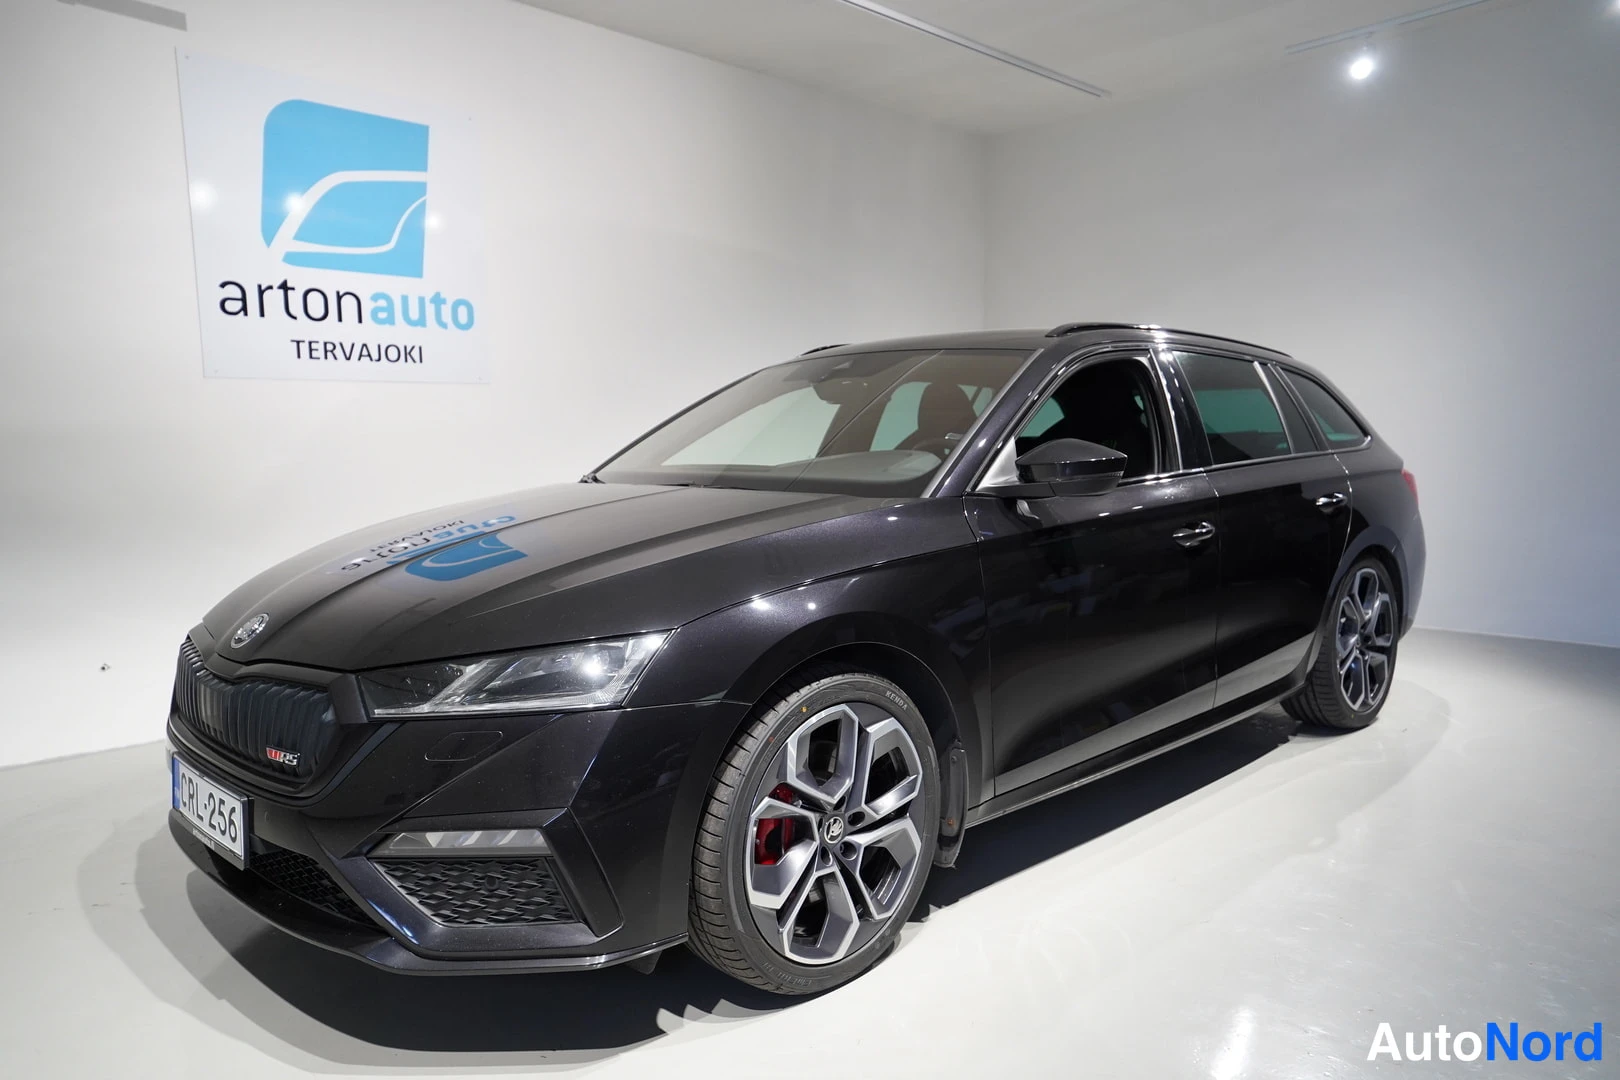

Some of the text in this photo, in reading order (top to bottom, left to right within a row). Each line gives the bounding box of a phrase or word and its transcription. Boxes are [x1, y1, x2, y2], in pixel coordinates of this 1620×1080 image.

[218, 279, 475, 331] artonauto
[290, 339, 424, 364] TERVAJOKI
[885, 690, 908, 711] KENDA
[181, 772, 238, 844] CRL-256
